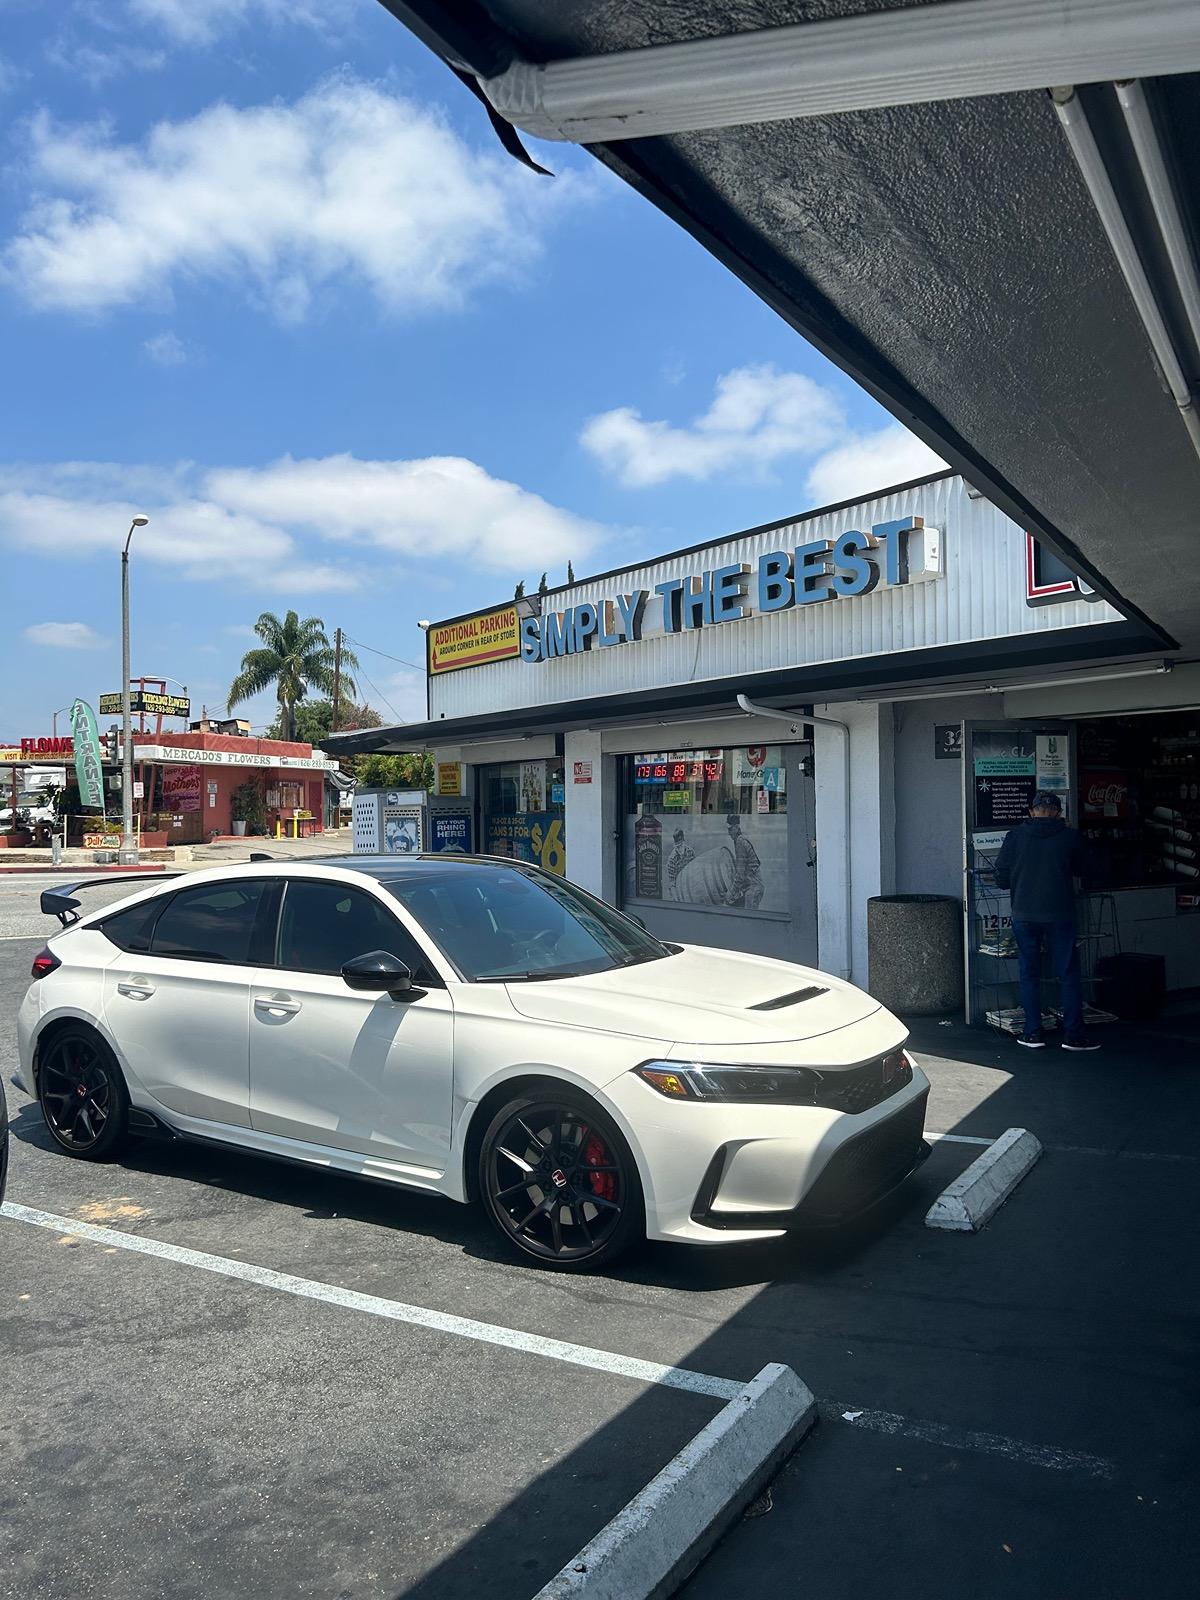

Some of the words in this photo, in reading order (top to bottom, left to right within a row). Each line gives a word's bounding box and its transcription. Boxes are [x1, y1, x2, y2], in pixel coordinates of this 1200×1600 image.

[520, 590, 650, 663] SIMPLY
[656, 563, 751, 633] THE
[758, 516, 924, 612] BEST
[435, 622, 478, 646] ADDITIONAL
[480, 611, 515, 634] PARKING
[440, 645, 456, 655] AROUND
[457, 640, 474, 651] CORNER
[481, 635, 492, 645] REAR
[493, 634, 499, 642] OF
[500, 629, 515, 640] STORE
[20, 737, 75, 753] FLOWE
[4, 752, 18, 760] VISIT
[20, 752, 27, 760] US
[163, 748, 222, 762] MERCADO'S
[228, 754, 272, 765] FLOWERS
[654, 765, 667, 777] 166
[737, 770, 765, 780] MoneyG
[766, 772, 776, 787] A
[489, 826, 507, 837] CANS
[508, 827, 513, 836] 2
[514, 826, 529, 838] FOR
[532, 820, 566, 876] $6
[983, 914, 998, 928] 12
[1002, 916, 1013, 929] PA
